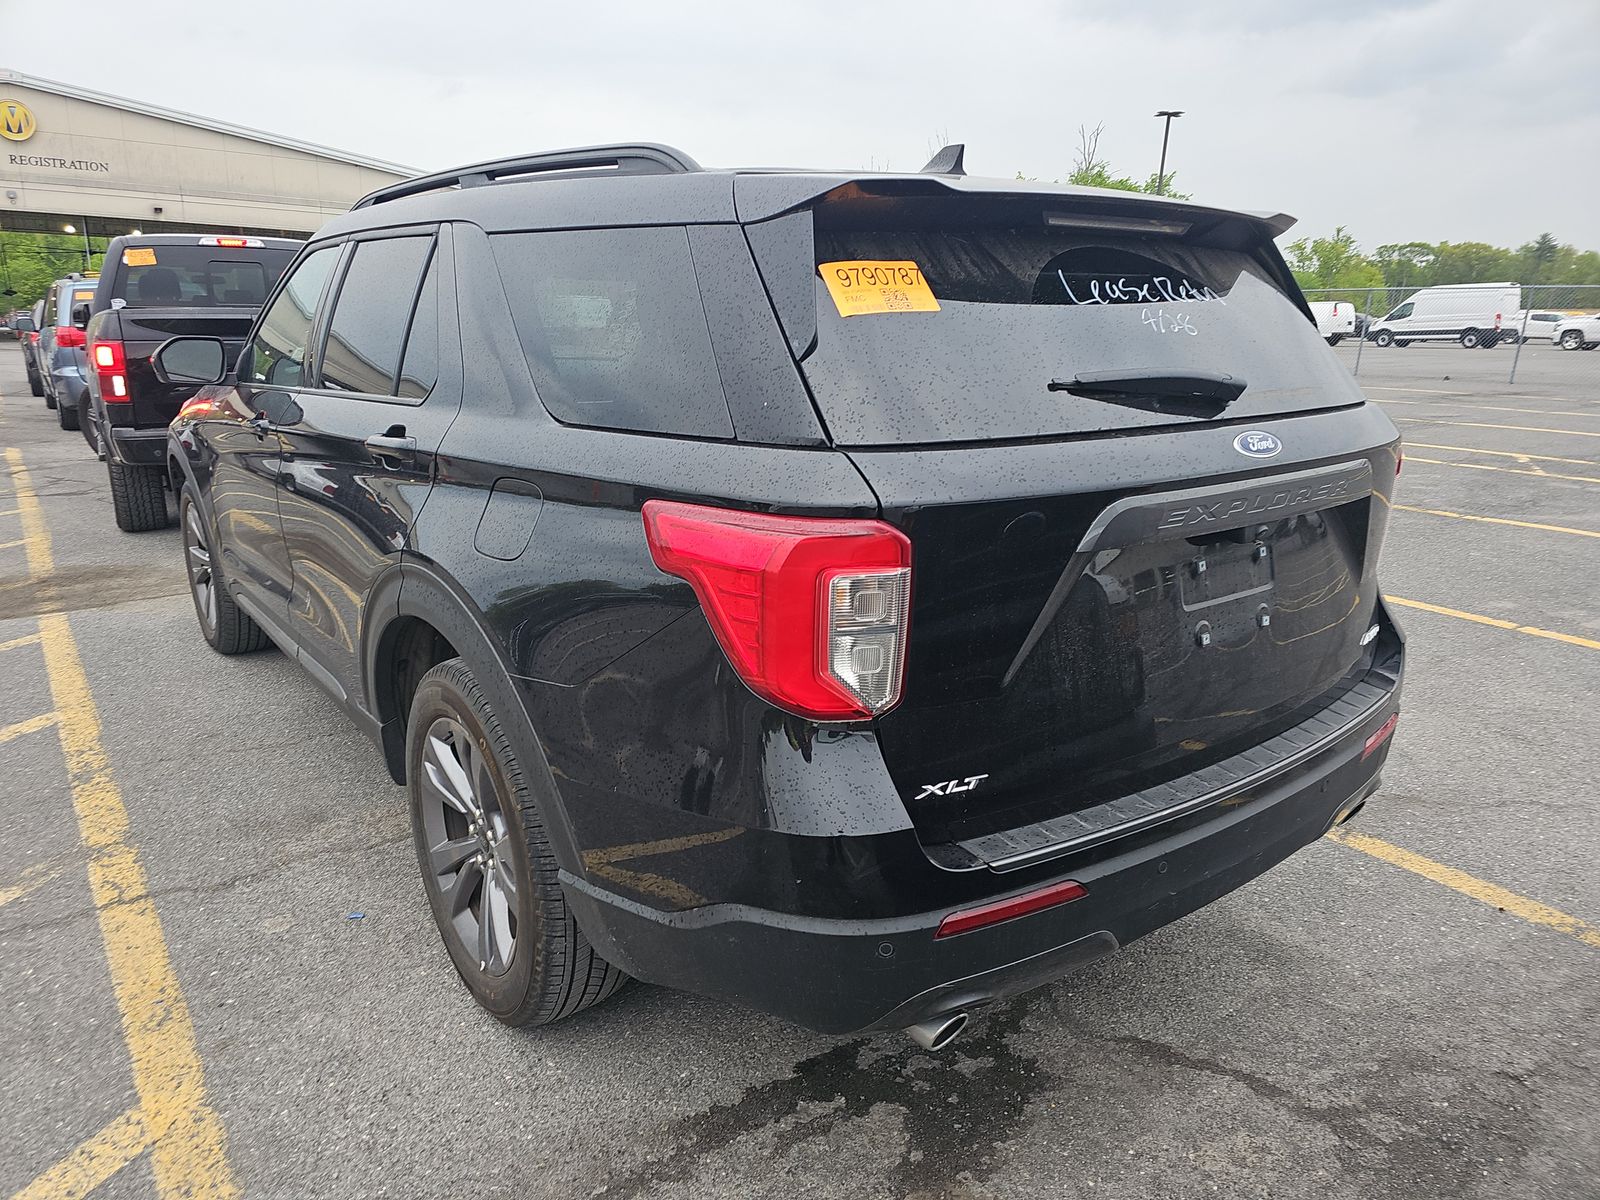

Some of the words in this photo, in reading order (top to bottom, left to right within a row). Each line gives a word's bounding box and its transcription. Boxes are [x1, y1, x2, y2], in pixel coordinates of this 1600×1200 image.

[9, 154, 109, 172] REGISTRATION
[836, 267, 921, 287] 9790787
[1247, 434, 1275, 451] Ford
[1157, 478, 1349, 530] EXPLORER
[914, 773, 989, 800] XLT
